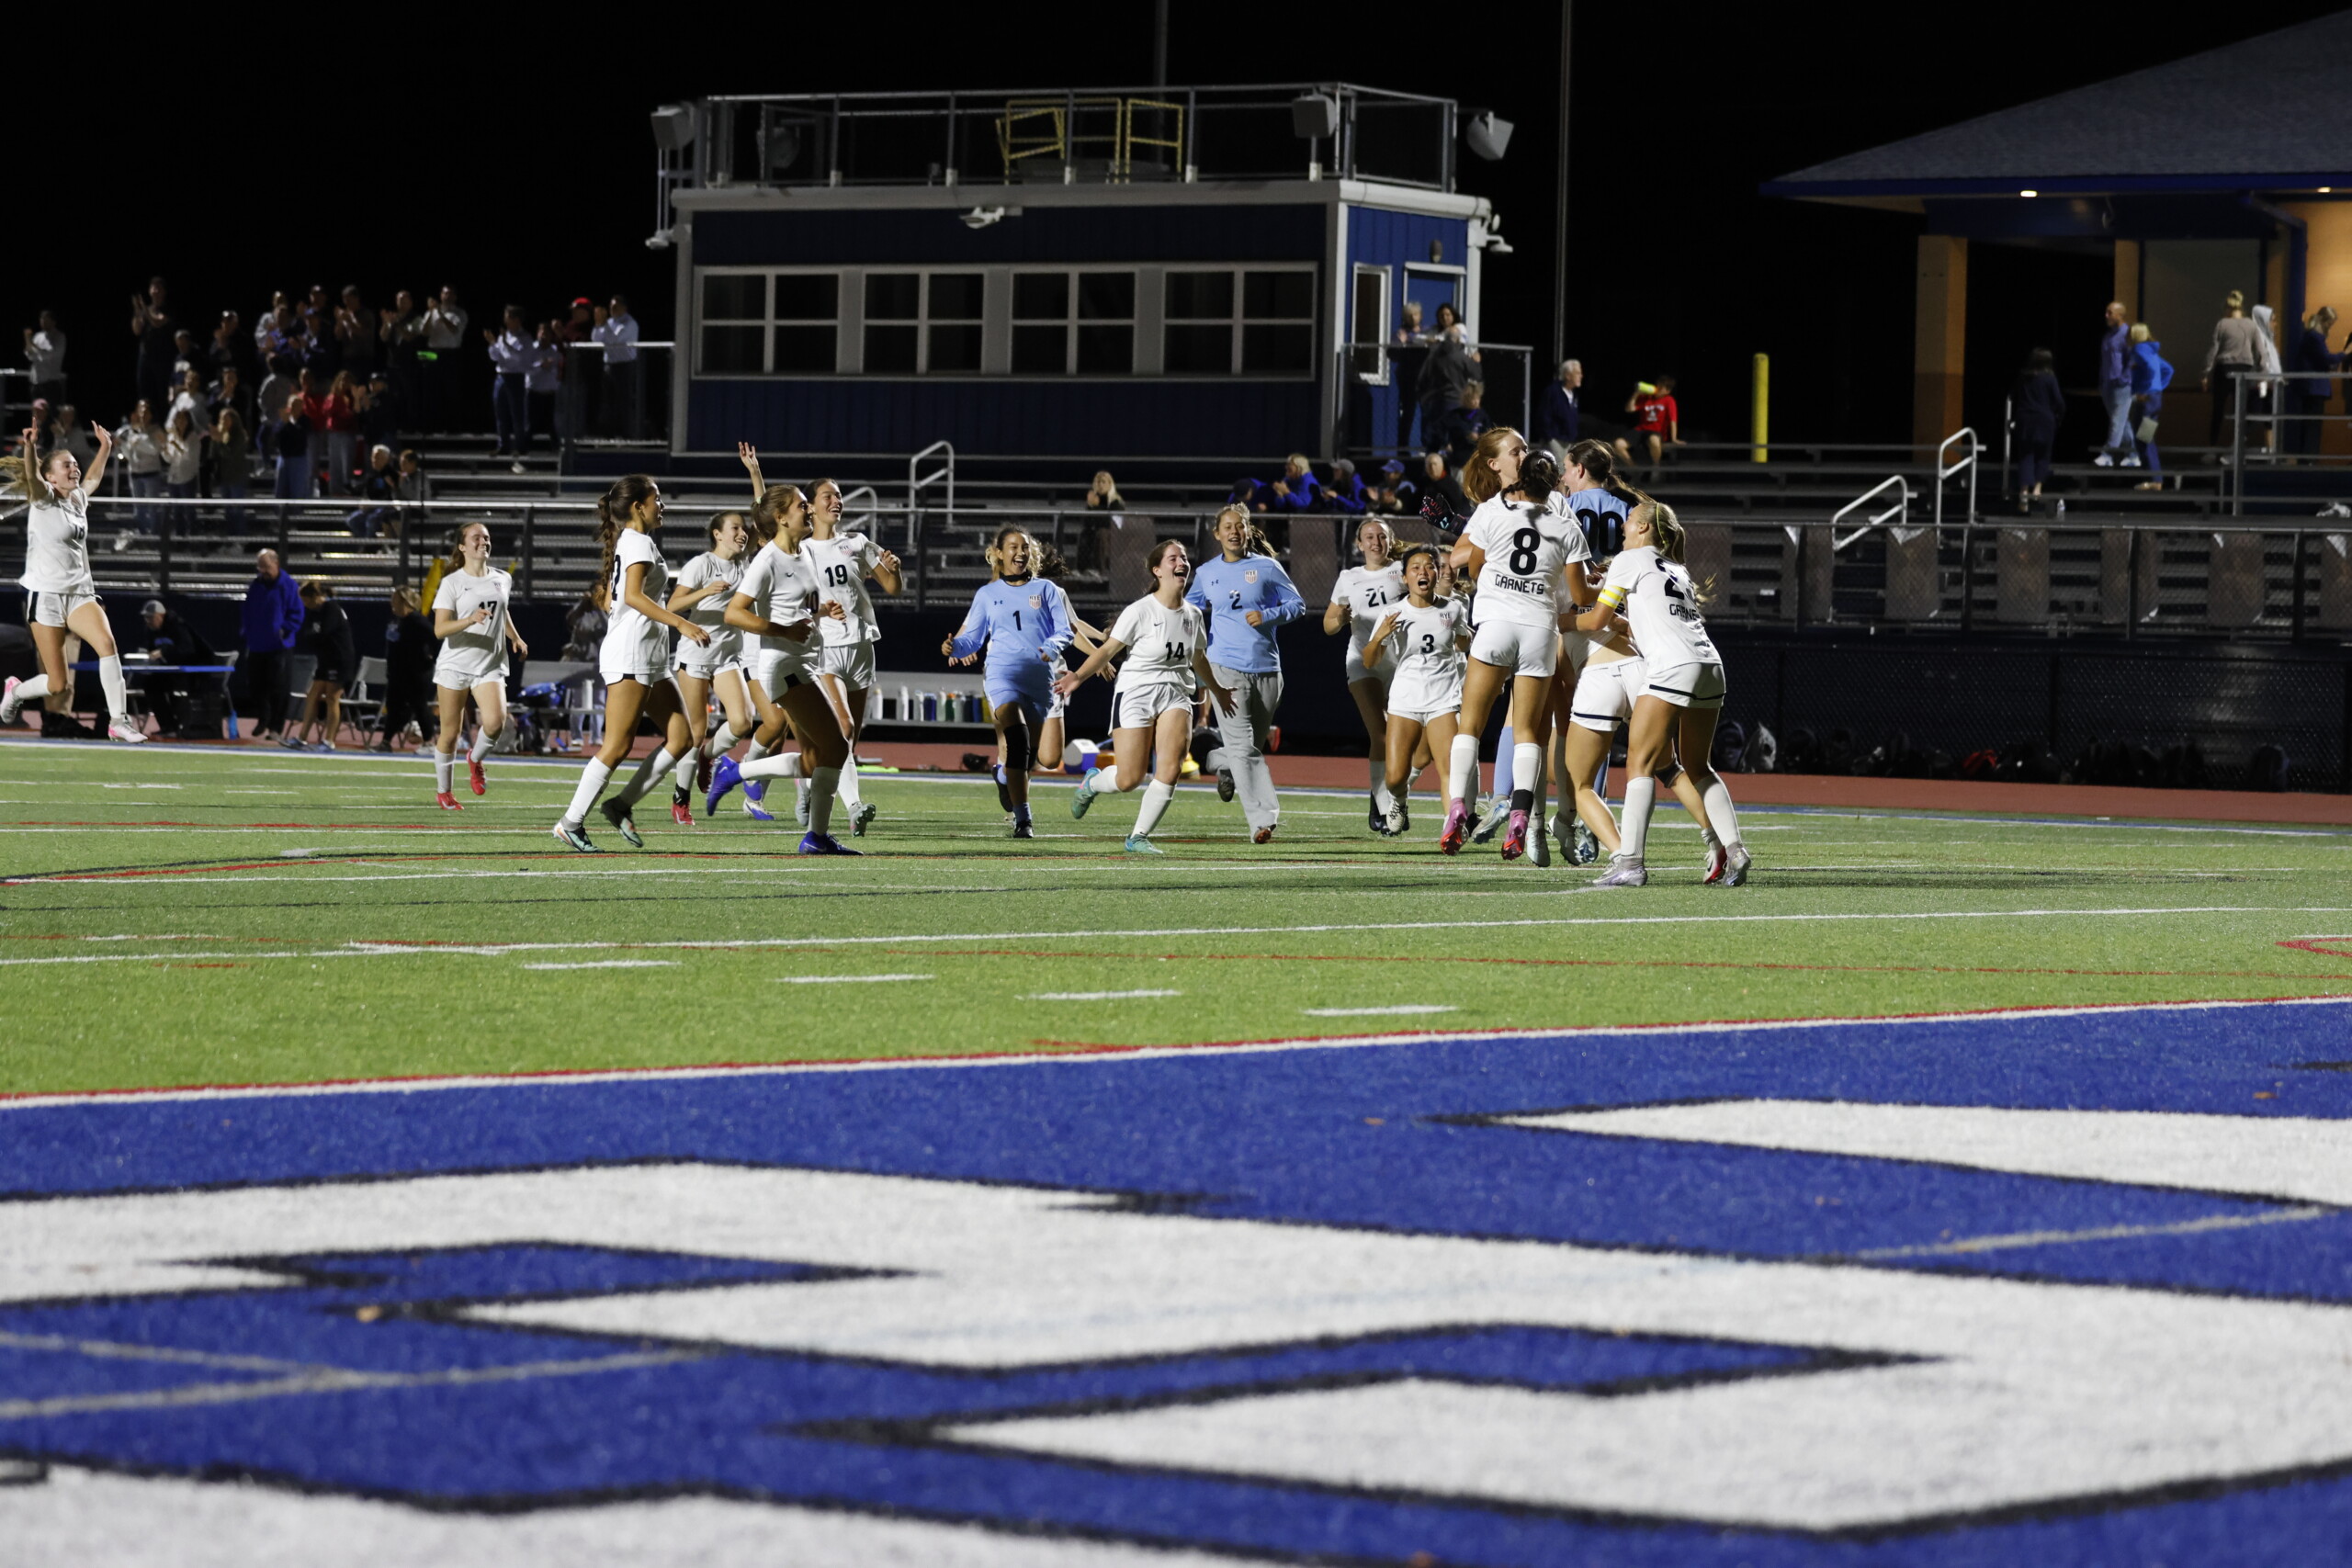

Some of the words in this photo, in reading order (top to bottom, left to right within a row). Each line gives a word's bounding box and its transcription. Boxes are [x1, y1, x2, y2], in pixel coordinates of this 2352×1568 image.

[1510, 527, 1540, 576] 8
[825, 564, 848, 587] 19
[1494, 573, 1545, 595] GARNETS
[1228, 590, 1243, 610] 2
[1365, 585, 1388, 608] 21
[1012, 610, 1023, 631] 1
[1668, 604, 1700, 621] GARNE
[1165, 641, 1185, 661] 14
[1420, 634, 1435, 654] 3
